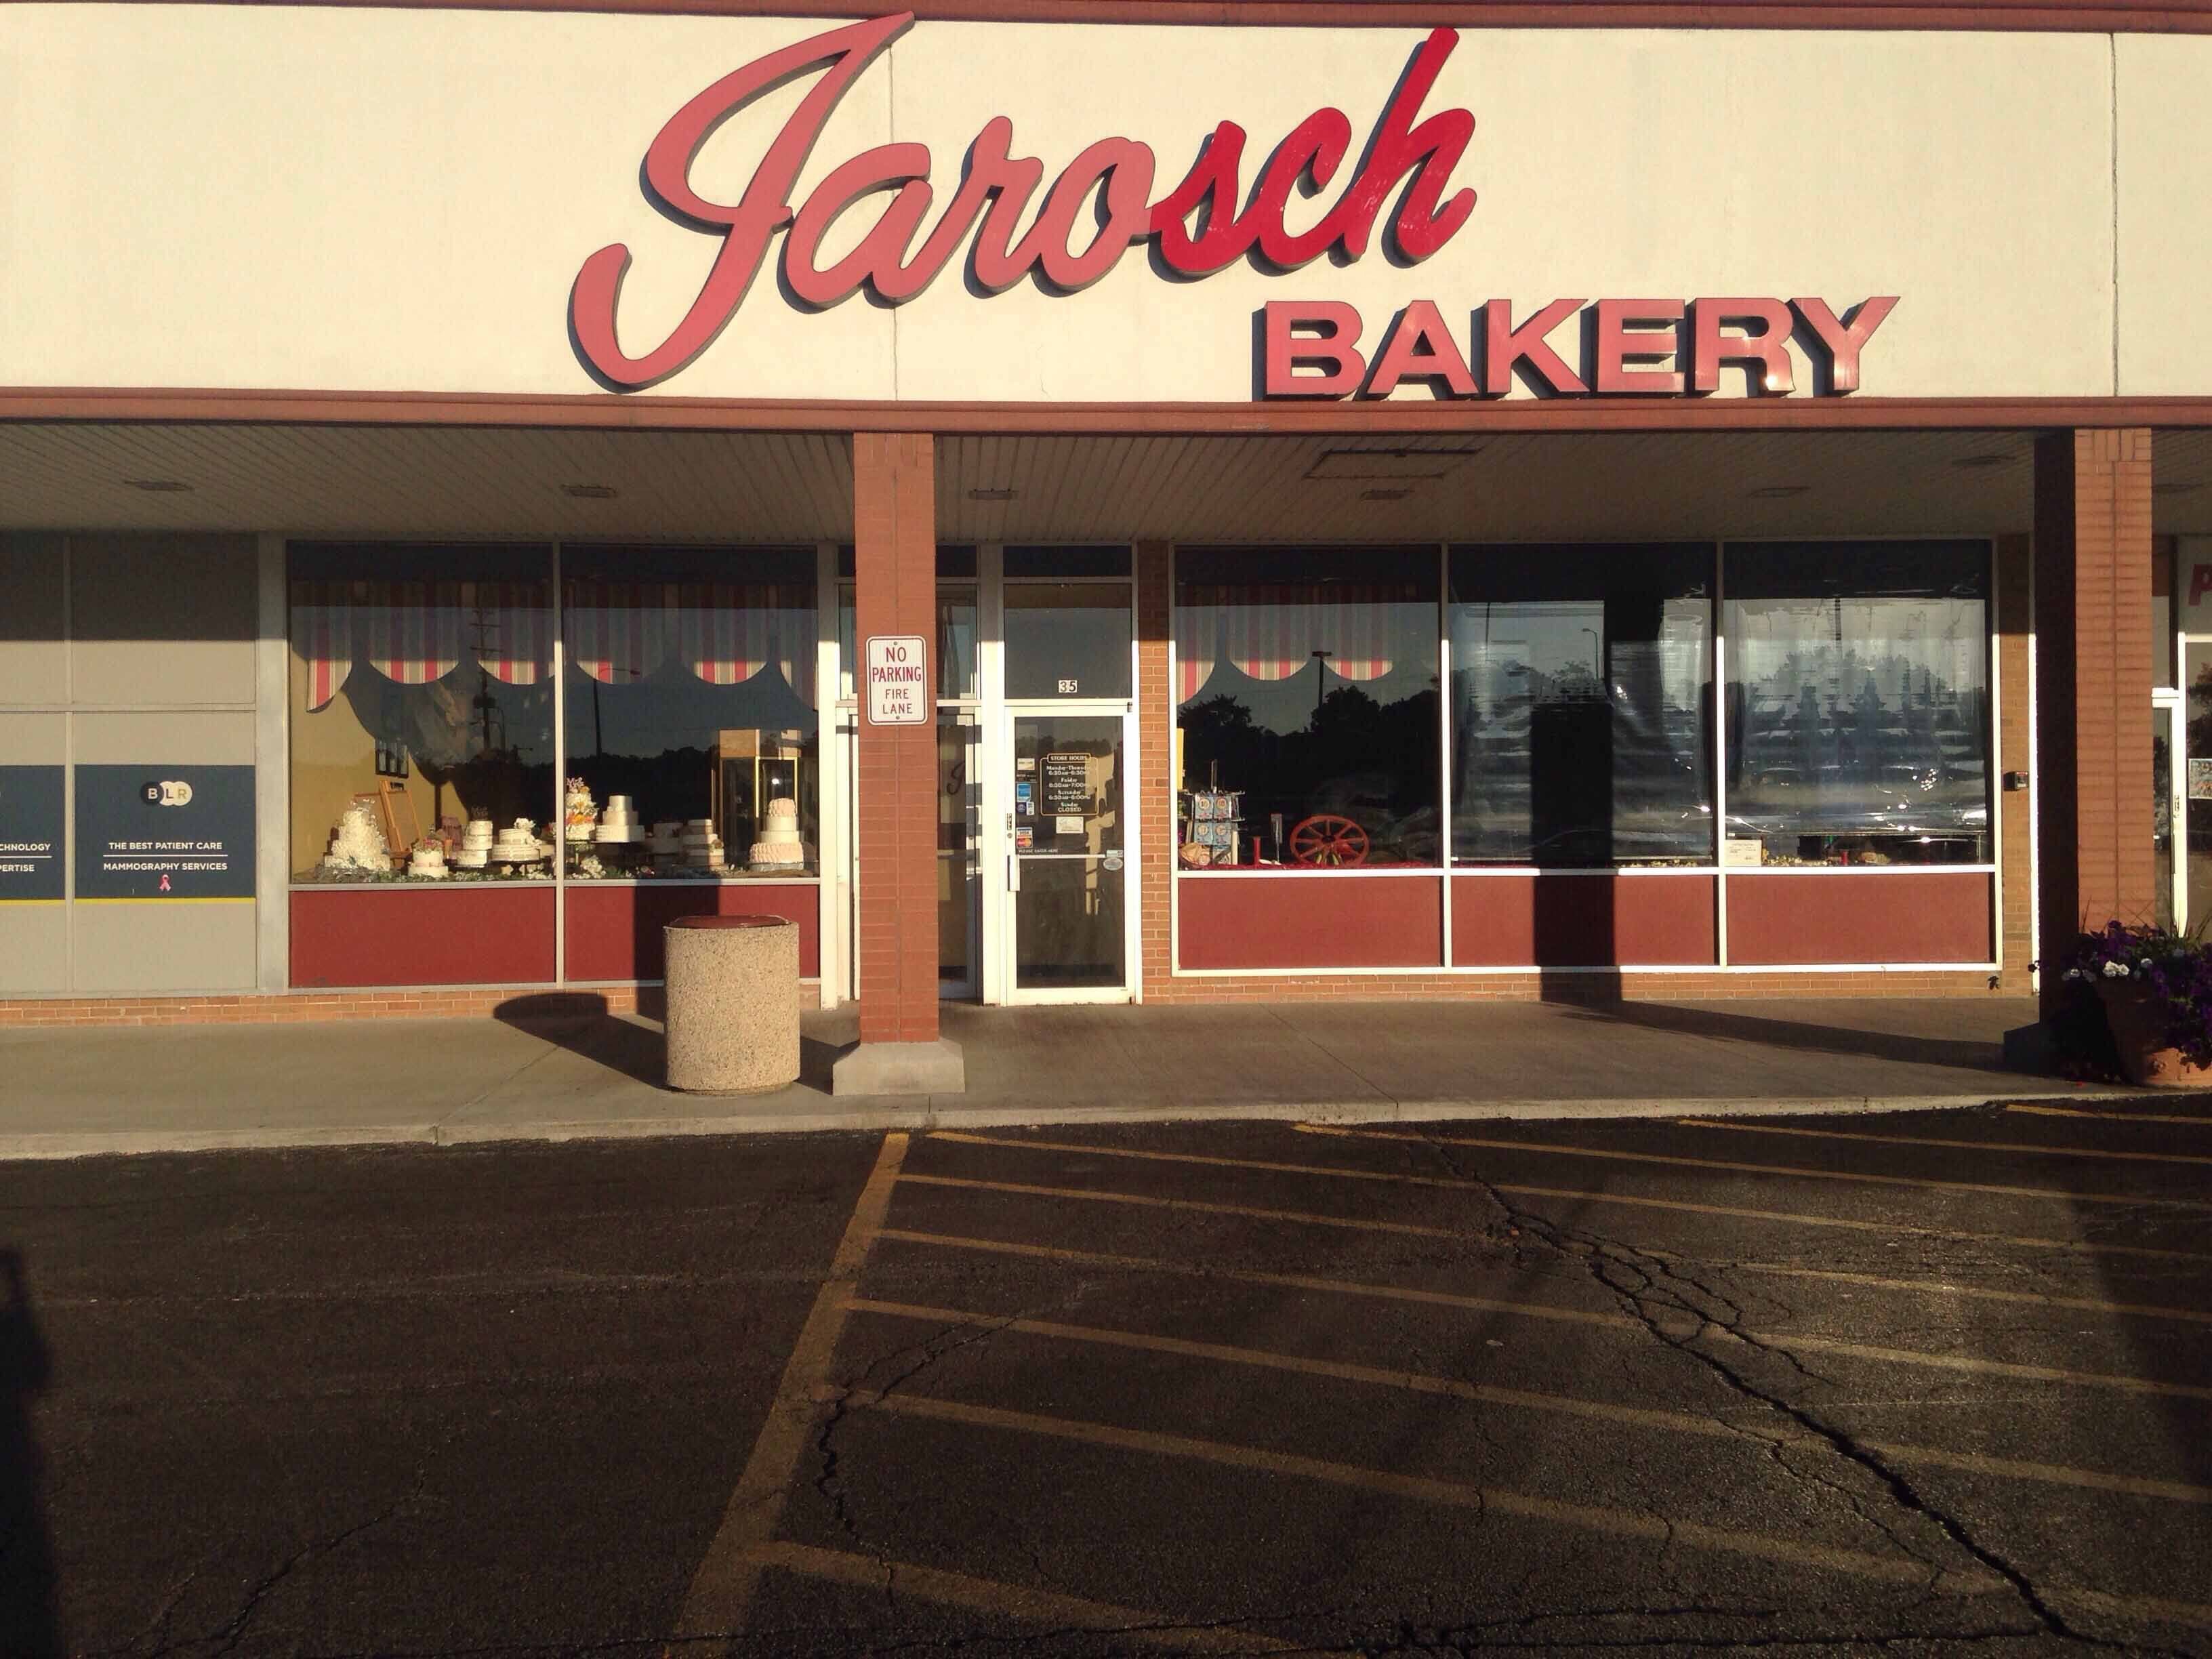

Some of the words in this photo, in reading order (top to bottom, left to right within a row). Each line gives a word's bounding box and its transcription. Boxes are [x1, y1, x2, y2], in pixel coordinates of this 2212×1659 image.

[571, 12, 1477, 396] Jarosch
[1254, 294, 1899, 403] BAKERY
[886, 647, 907, 662] NO
[872, 666, 922, 682] PARKING
[1059, 681, 1076, 692] 35
[885, 689, 909, 699] FIRE
[882, 703, 913, 714] LANE
[148, 788, 187, 800] BLR
[103, 863, 180, 871] MAMMOGRAPHY
[182, 863, 228, 871] SERVICES
